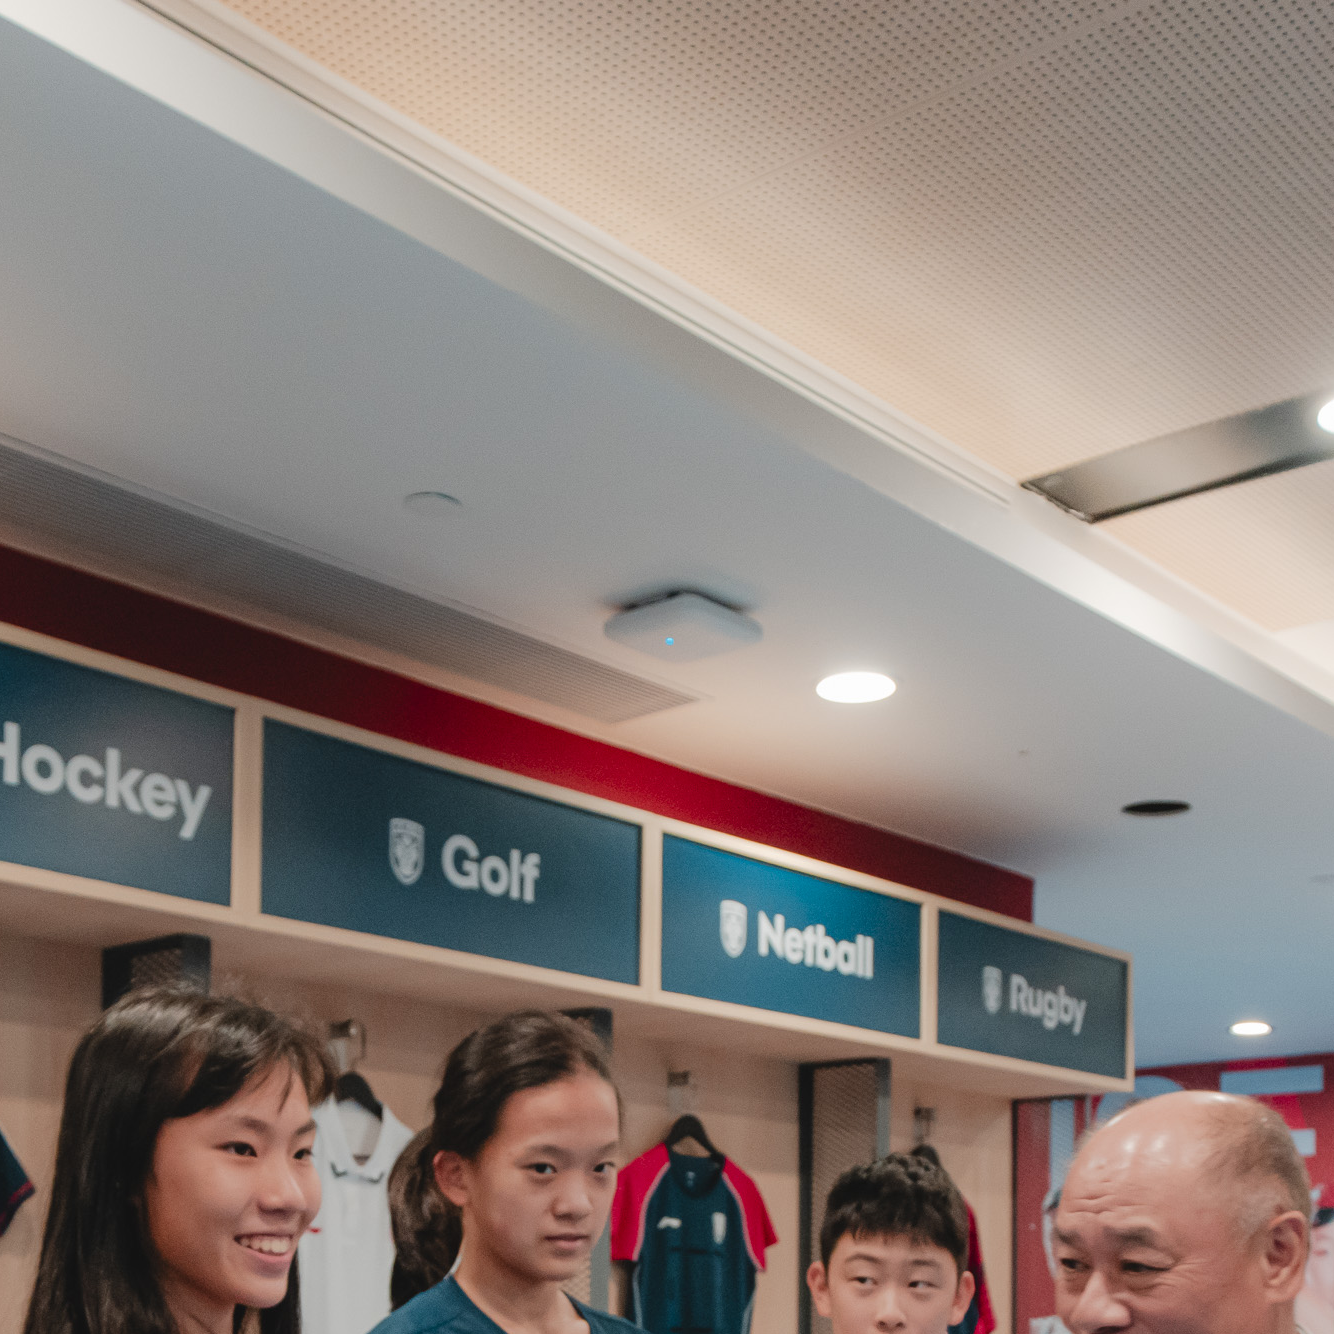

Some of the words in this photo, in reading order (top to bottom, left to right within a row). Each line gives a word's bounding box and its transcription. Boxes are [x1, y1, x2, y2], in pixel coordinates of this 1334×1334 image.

[441, 833, 541, 904] Golf
[757, 910, 874, 979] Netball
[1008, 973, 1088, 1036] Rugby
